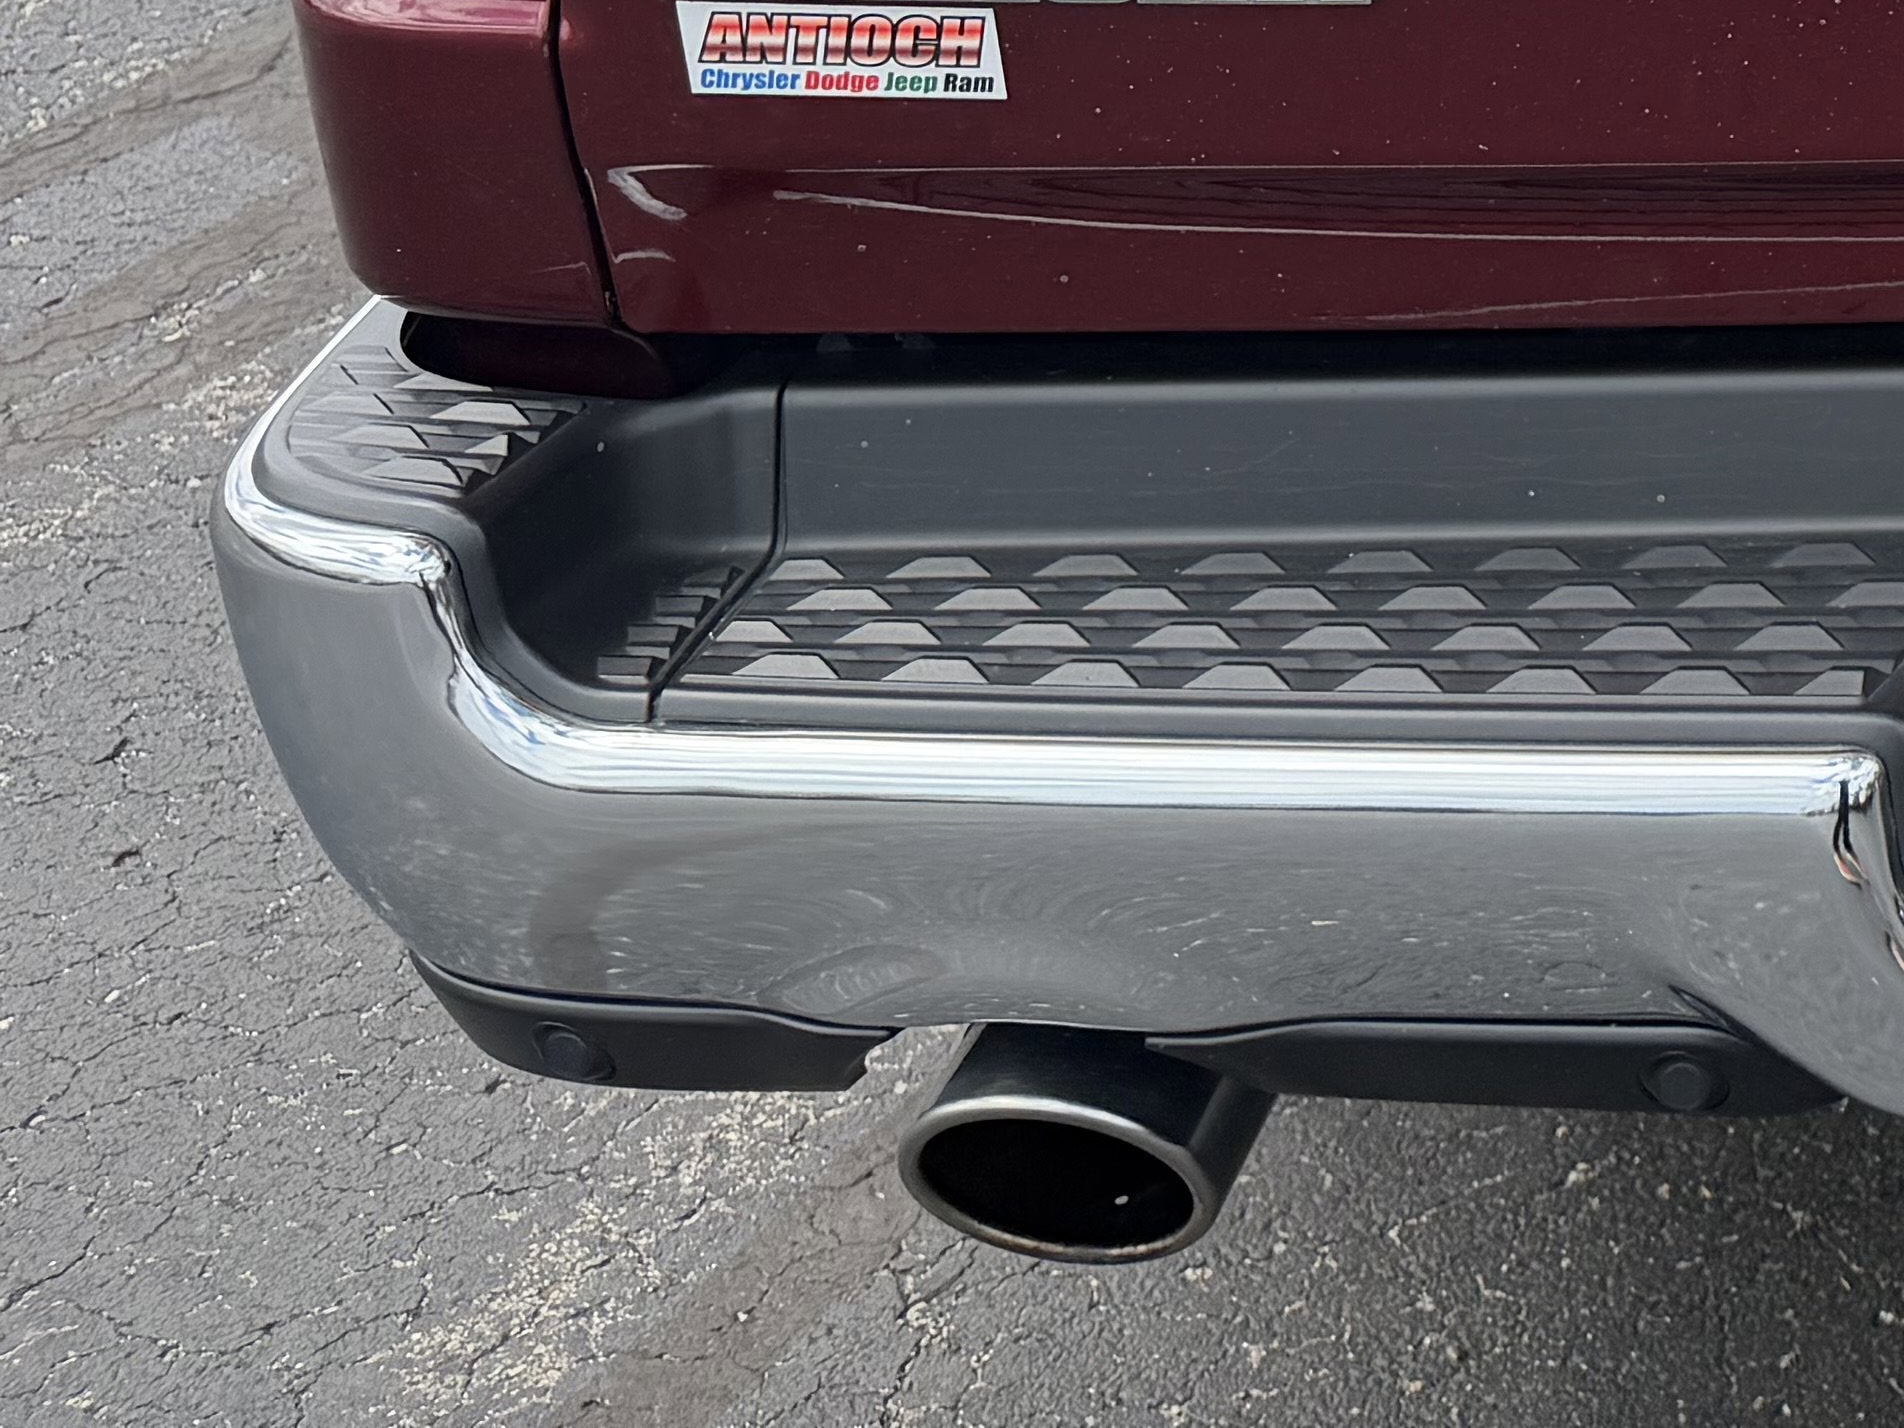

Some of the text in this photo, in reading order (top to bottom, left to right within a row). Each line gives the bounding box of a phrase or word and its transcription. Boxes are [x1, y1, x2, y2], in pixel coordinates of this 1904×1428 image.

[698, 11, 985, 68] ANTIOCH
[700, 68, 994, 94] Chrysler Dodge Jeep Ram
